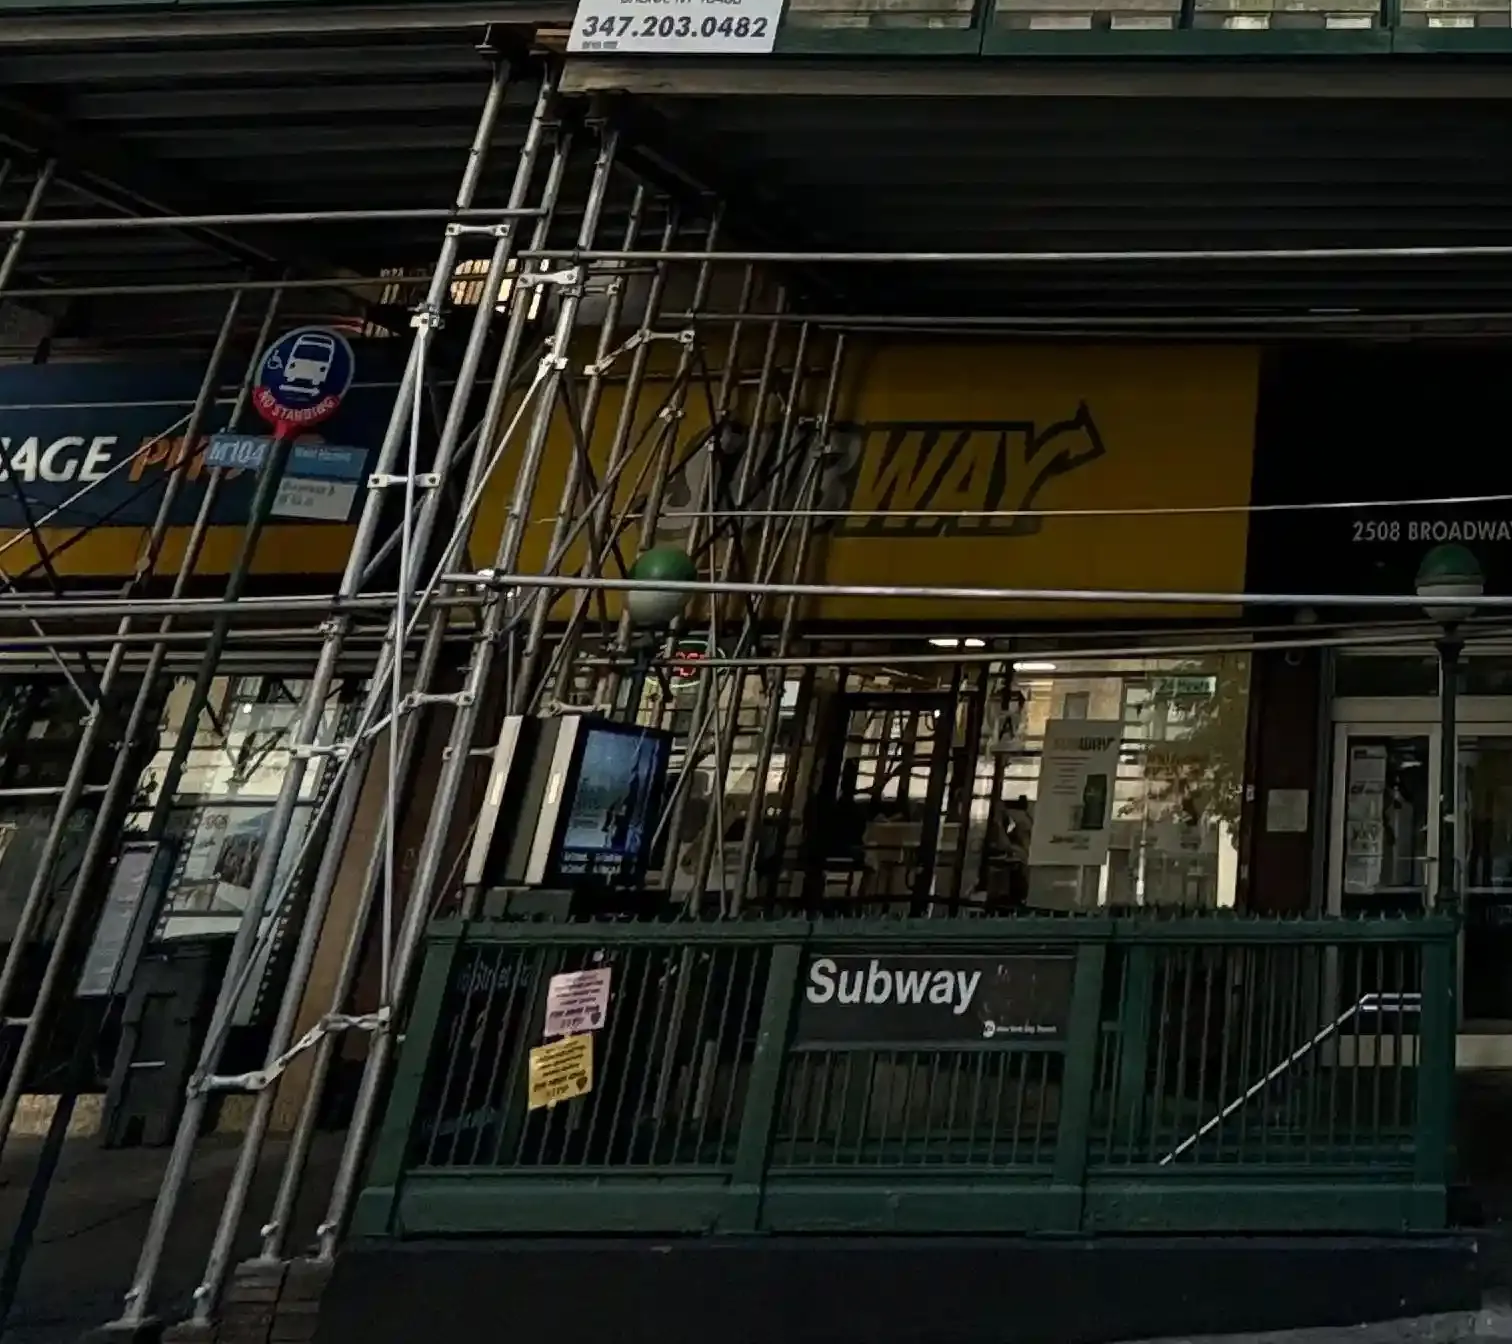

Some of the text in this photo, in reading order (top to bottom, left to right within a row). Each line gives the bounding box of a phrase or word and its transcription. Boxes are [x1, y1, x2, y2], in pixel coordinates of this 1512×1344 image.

[582, 16, 769, 38] 347.203.0482
[271, 395, 336, 422] STANDING
[1352, 520, 1401, 541] 2508
[806, 958, 983, 1016] Subway
